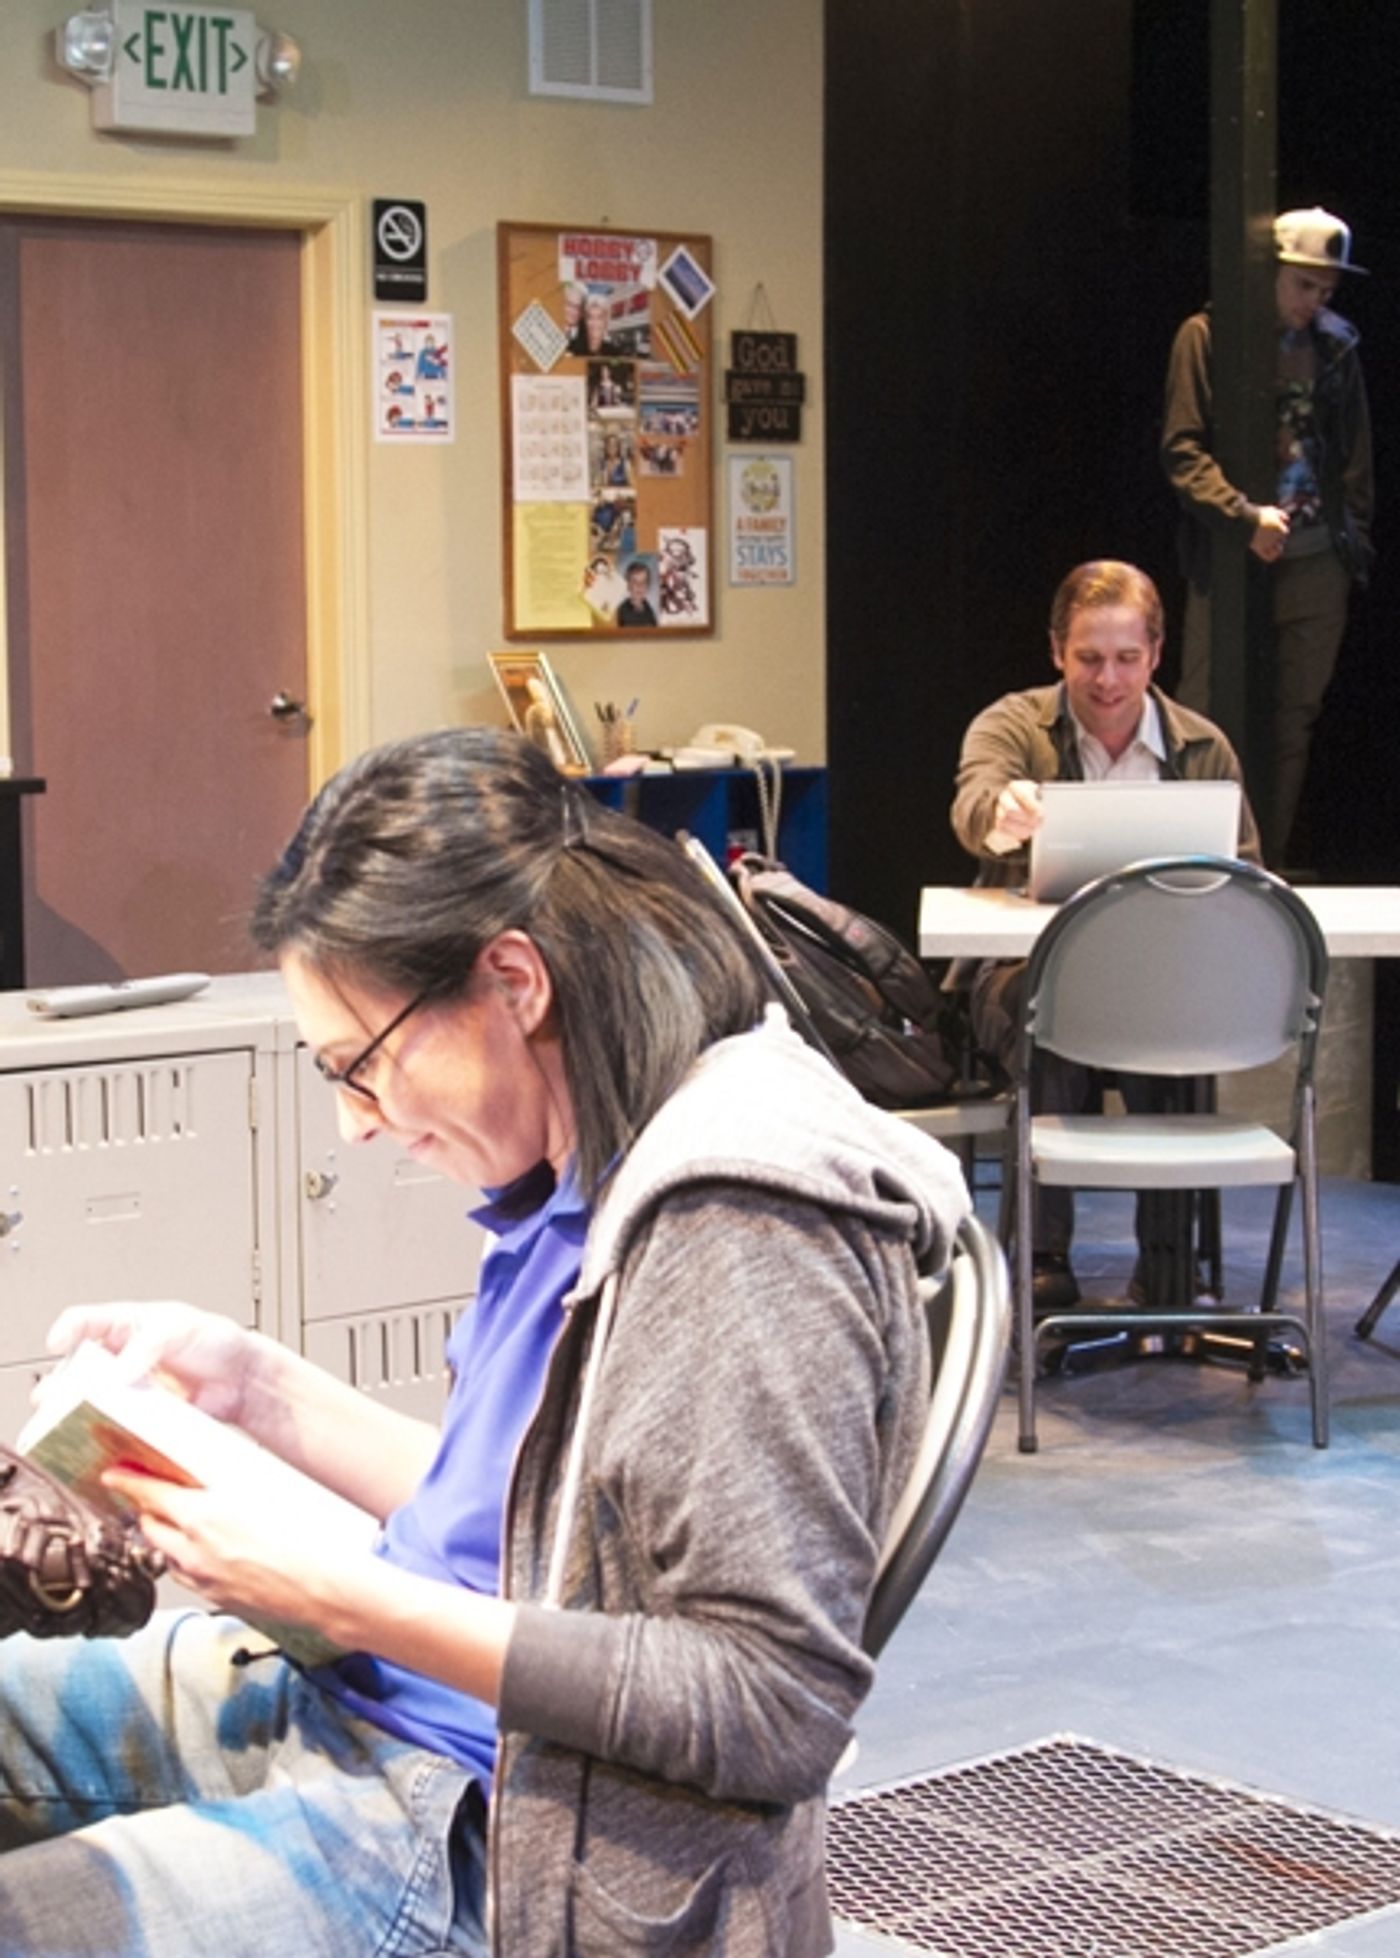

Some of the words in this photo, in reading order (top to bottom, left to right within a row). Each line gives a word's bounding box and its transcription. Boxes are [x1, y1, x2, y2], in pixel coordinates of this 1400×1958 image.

[144, 9, 234, 95] EXIT
[563, 235, 635, 260] HOBBY
[574, 259, 643, 283] LOBBY
[737, 335, 790, 369] God
[740, 405, 789, 437] you
[737, 544, 788, 567] STAYS
